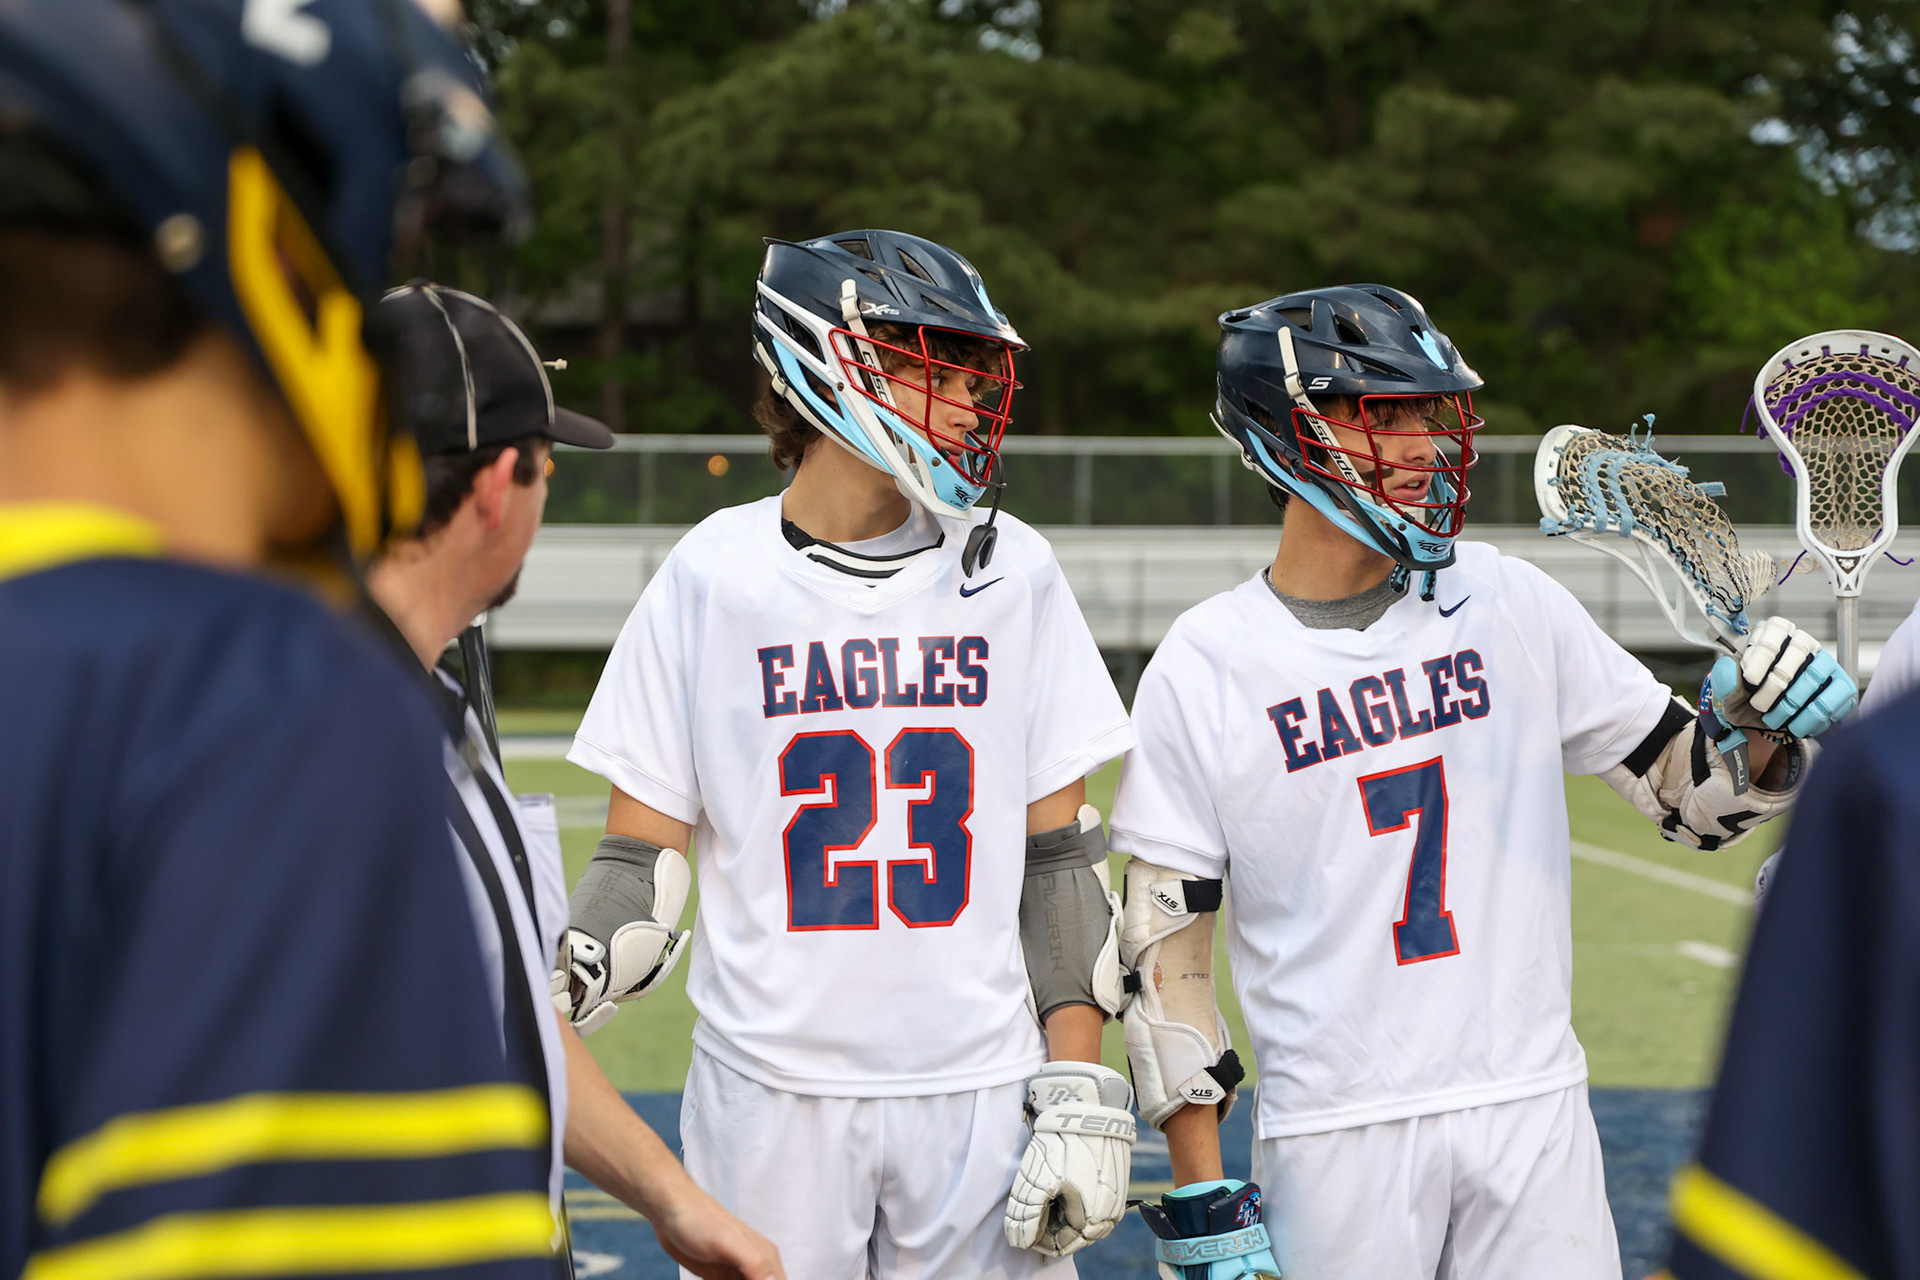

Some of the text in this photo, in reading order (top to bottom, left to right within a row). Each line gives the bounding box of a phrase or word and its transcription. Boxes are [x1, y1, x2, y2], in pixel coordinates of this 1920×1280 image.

[757, 636, 989, 718] EAGLES
[1266, 648, 1491, 773] EAGLES
[778, 727, 975, 932] 23
[1356, 755, 1461, 966] 7
[1157, 891, 1179, 909] STX
[1190, 1088, 1213, 1098] STX
[1162, 1227, 1264, 1260] MAVERIK
